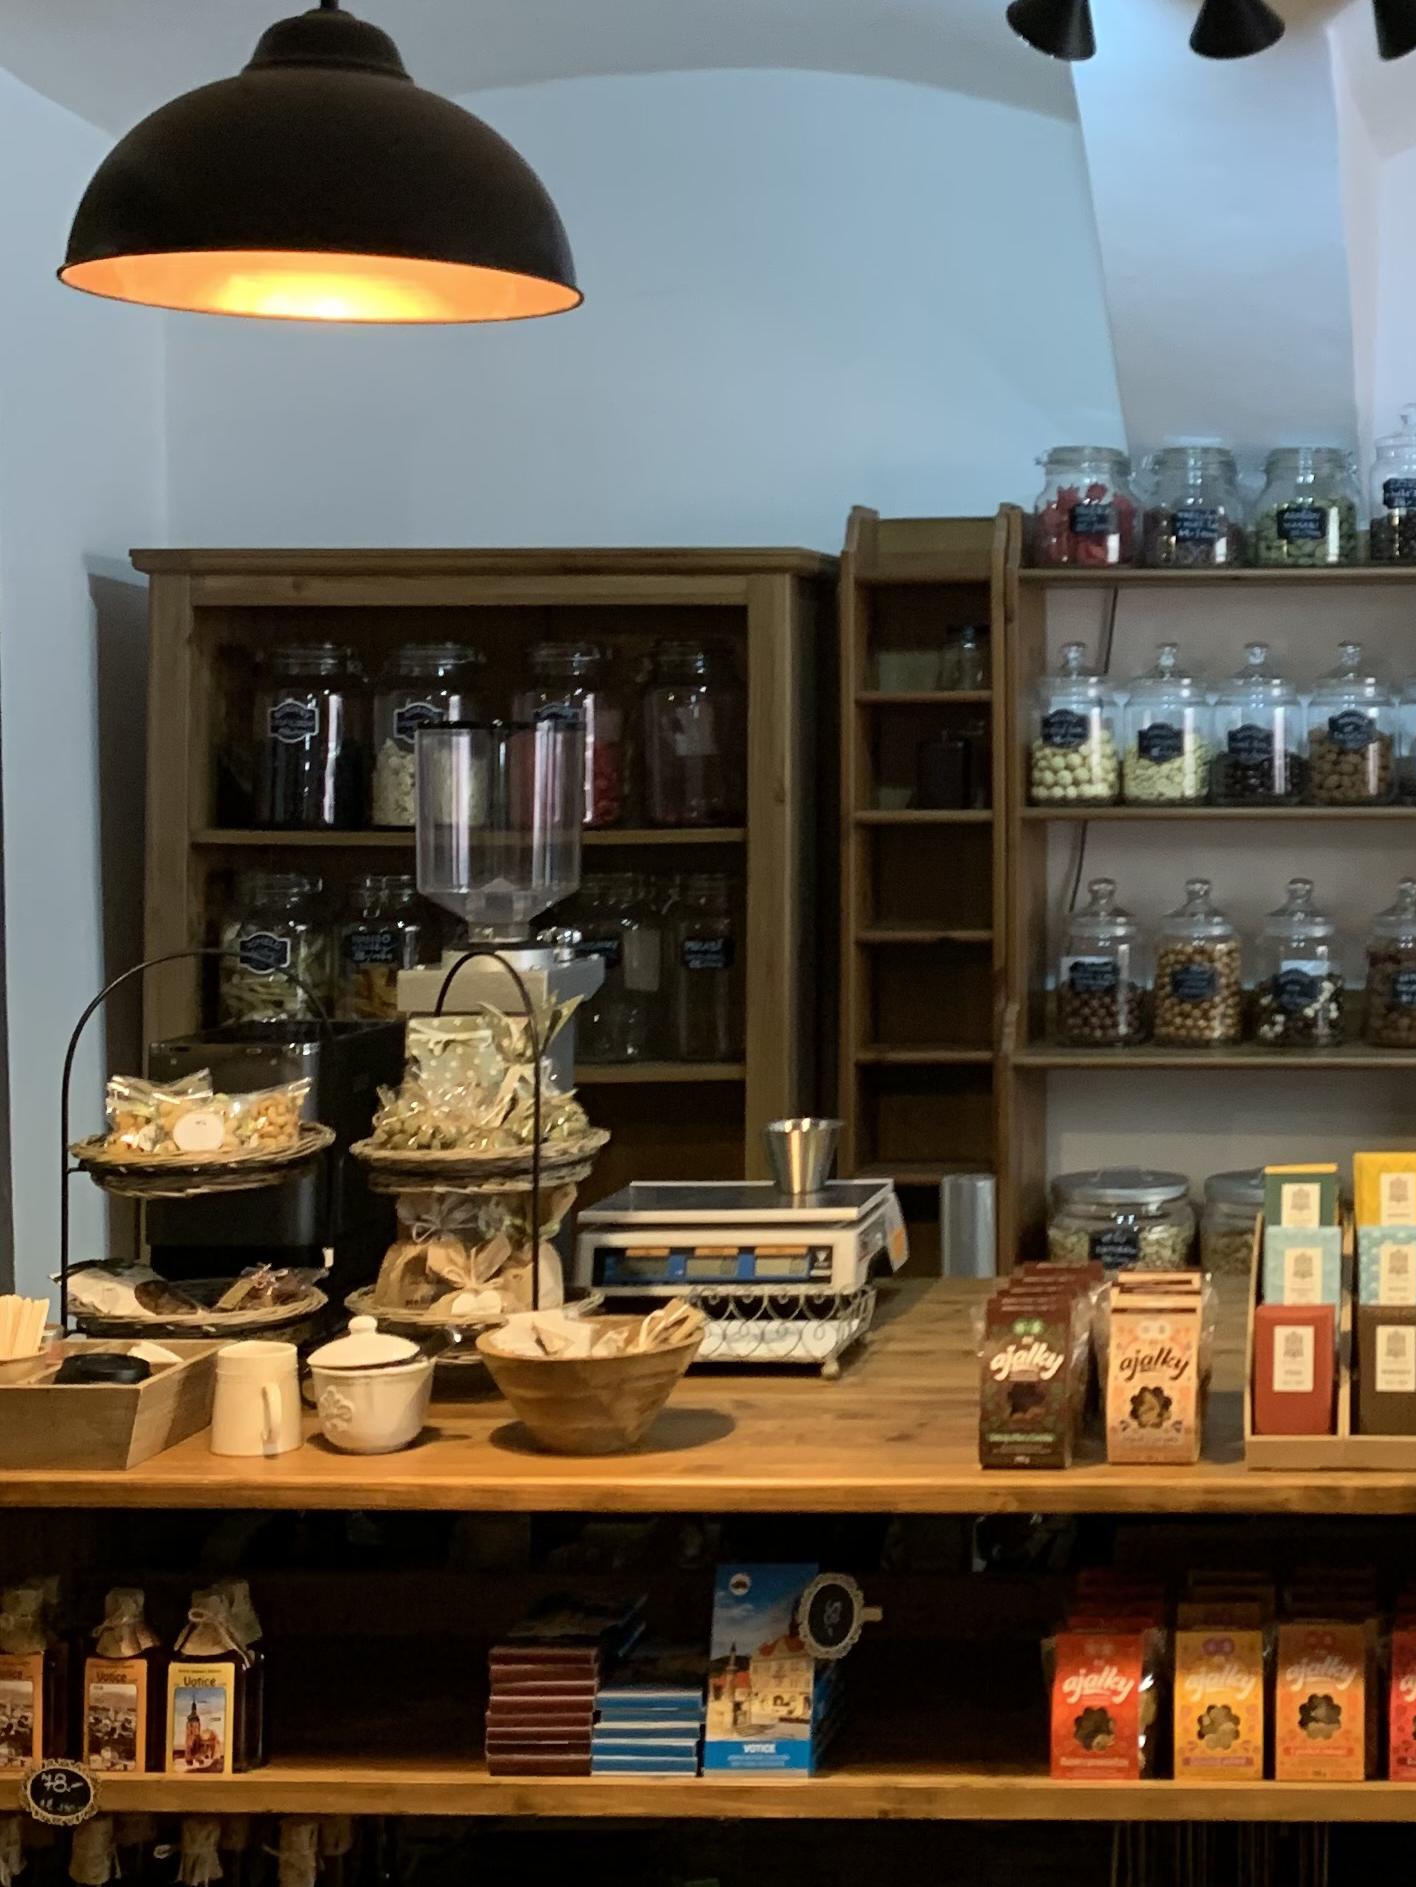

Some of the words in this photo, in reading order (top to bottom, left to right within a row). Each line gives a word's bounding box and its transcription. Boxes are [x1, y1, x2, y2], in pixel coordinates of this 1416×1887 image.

[989, 1340, 1065, 1382] ajalky
[1119, 1346, 1190, 1382] ajalky
[1062, 1666, 1135, 1704] ajalky
